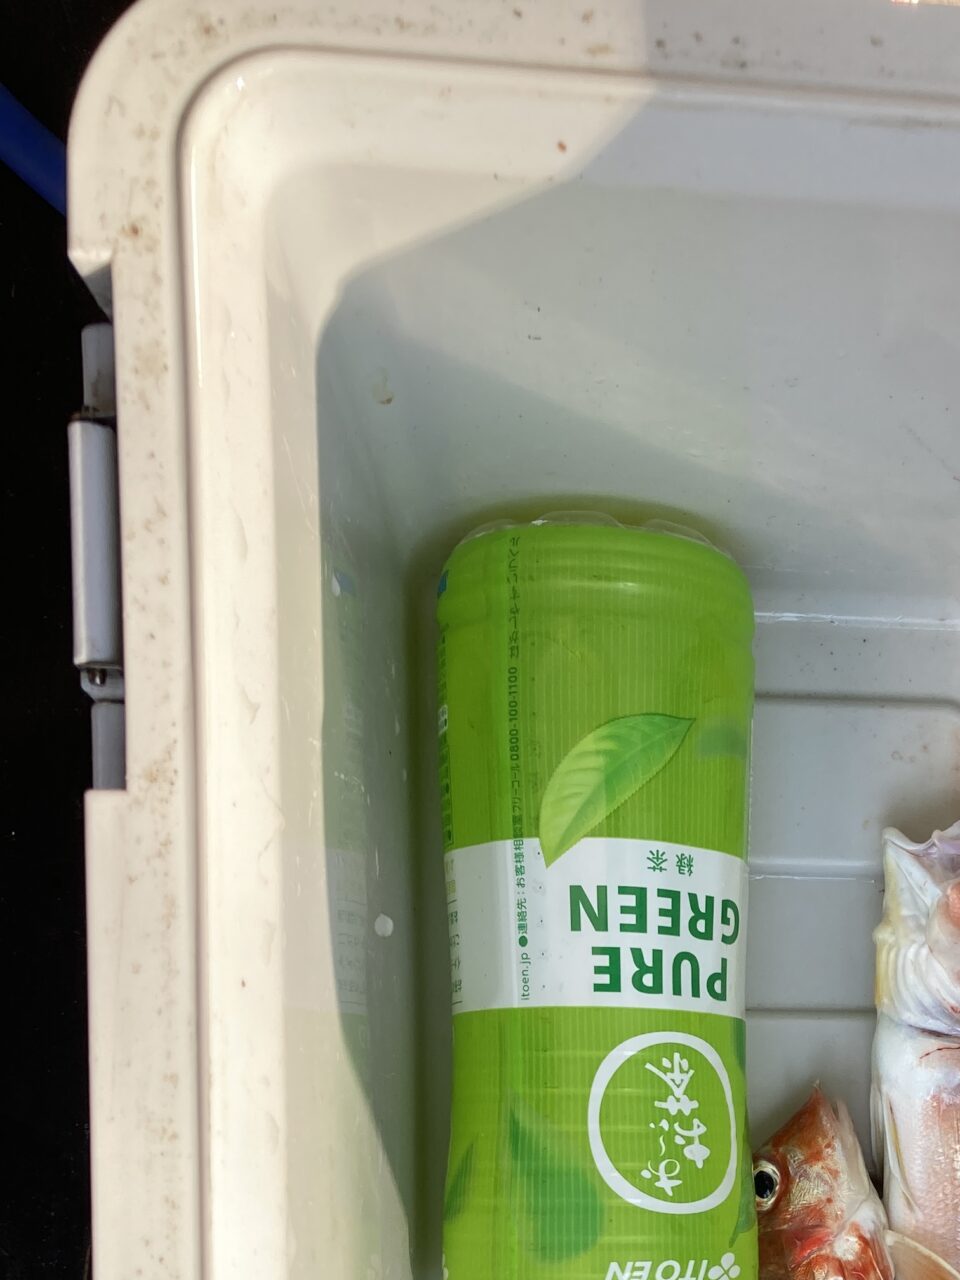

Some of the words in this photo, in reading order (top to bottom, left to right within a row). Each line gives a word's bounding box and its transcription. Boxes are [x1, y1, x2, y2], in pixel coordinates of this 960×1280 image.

[507, 536, 520, 658] はがしやすいラベル
[646, 849, 695, 877] 緑茶
[569, 883, 741, 946] GREEN
[519, 951, 532, 1001] itoen.jp
[591, 946, 728, 1002] PURE
